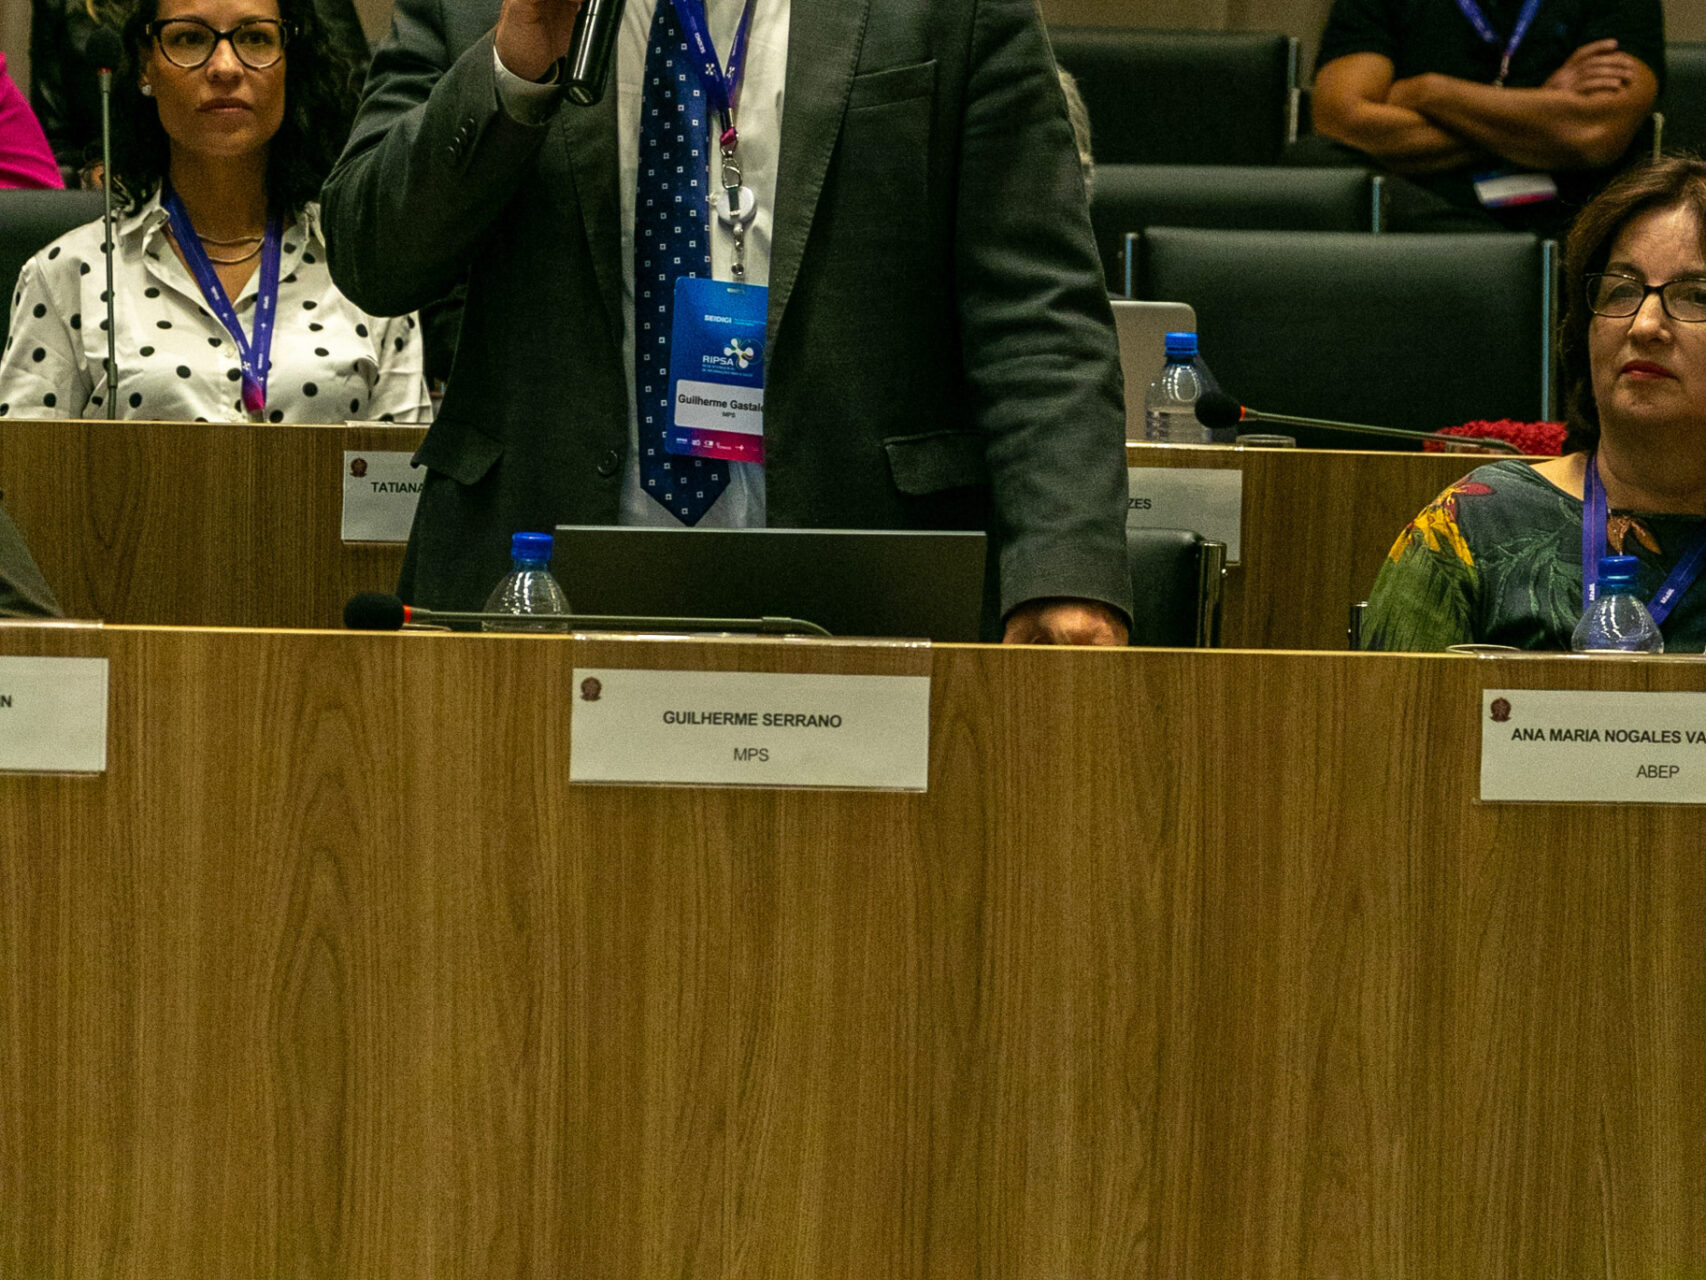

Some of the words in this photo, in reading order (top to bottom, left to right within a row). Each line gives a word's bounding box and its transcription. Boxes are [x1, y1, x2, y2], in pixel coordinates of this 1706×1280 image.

[702, 354, 734, 366] RIPSA
[678, 393, 728, 408] Guilherme
[663, 710, 758, 726] GUILHERME
[762, 713, 842, 728] SERRANO
[1511, 728, 1545, 741] ANA
[1549, 728, 1600, 742] MARIA
[1604, 729, 1681, 744] NOGALES
[733, 748, 769, 762] MPS
[1636, 764, 1680, 779] ABEP
